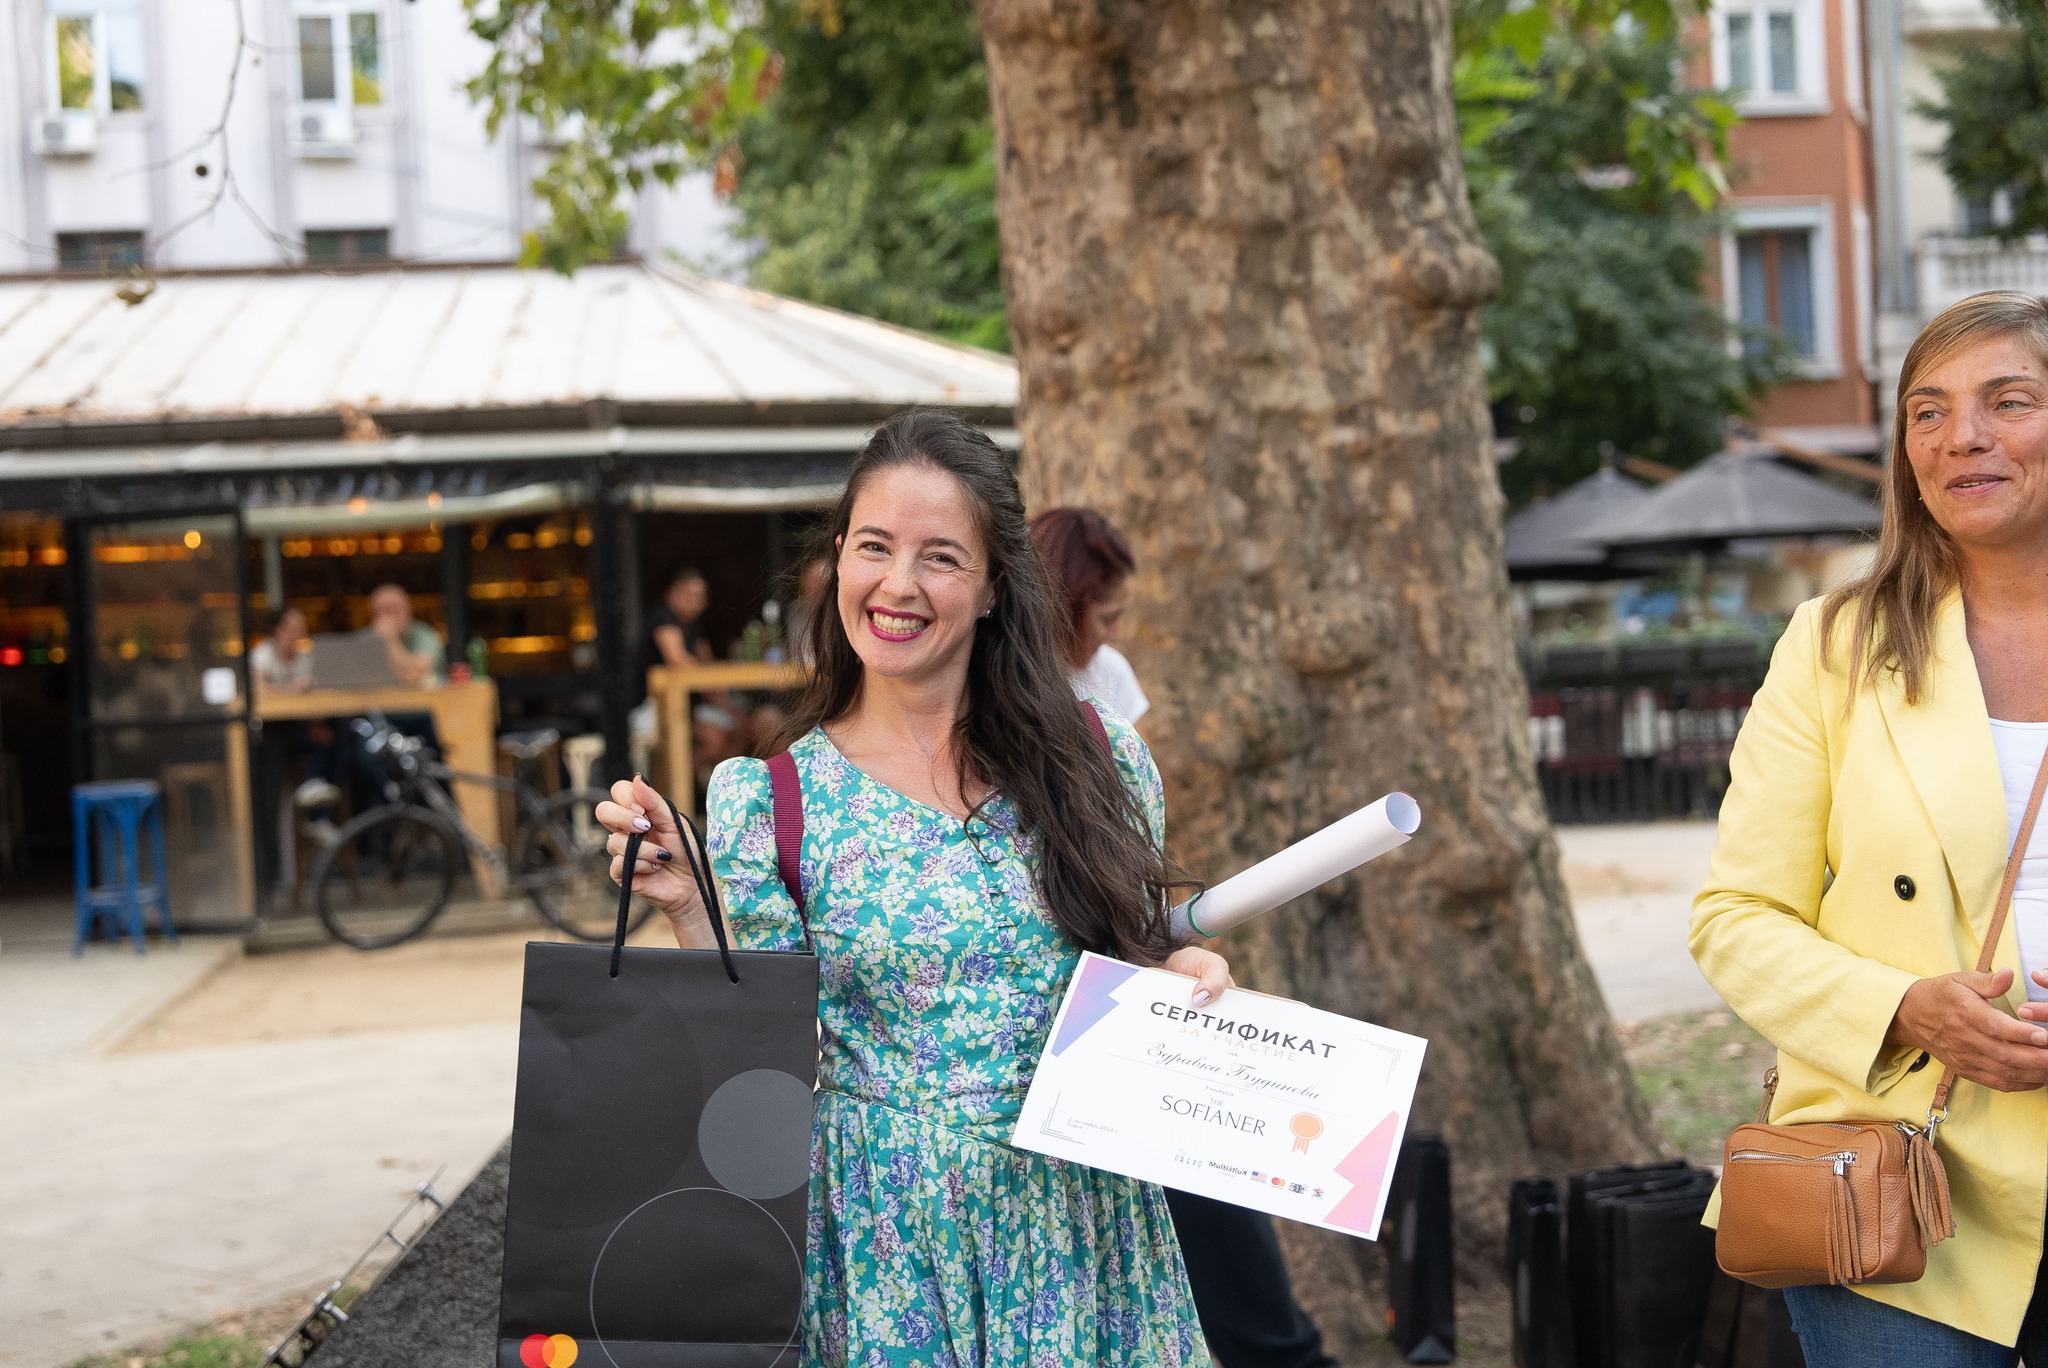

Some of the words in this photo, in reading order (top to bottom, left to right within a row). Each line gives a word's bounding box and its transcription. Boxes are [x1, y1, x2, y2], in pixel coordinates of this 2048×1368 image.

[1150, 1001, 1337, 1059] СЕРТИФИКАТ
[1178, 1024, 1200, 1037] ЗА
[1212, 1033, 1297, 1062] УЧАСТИЕ
[1147, 1040, 1221, 1073] Здравка
[1226, 1062, 1321, 1100] Будинова
[1160, 1094, 1267, 1137] SOFIANER
[1209, 1097, 1224, 1107] THE
